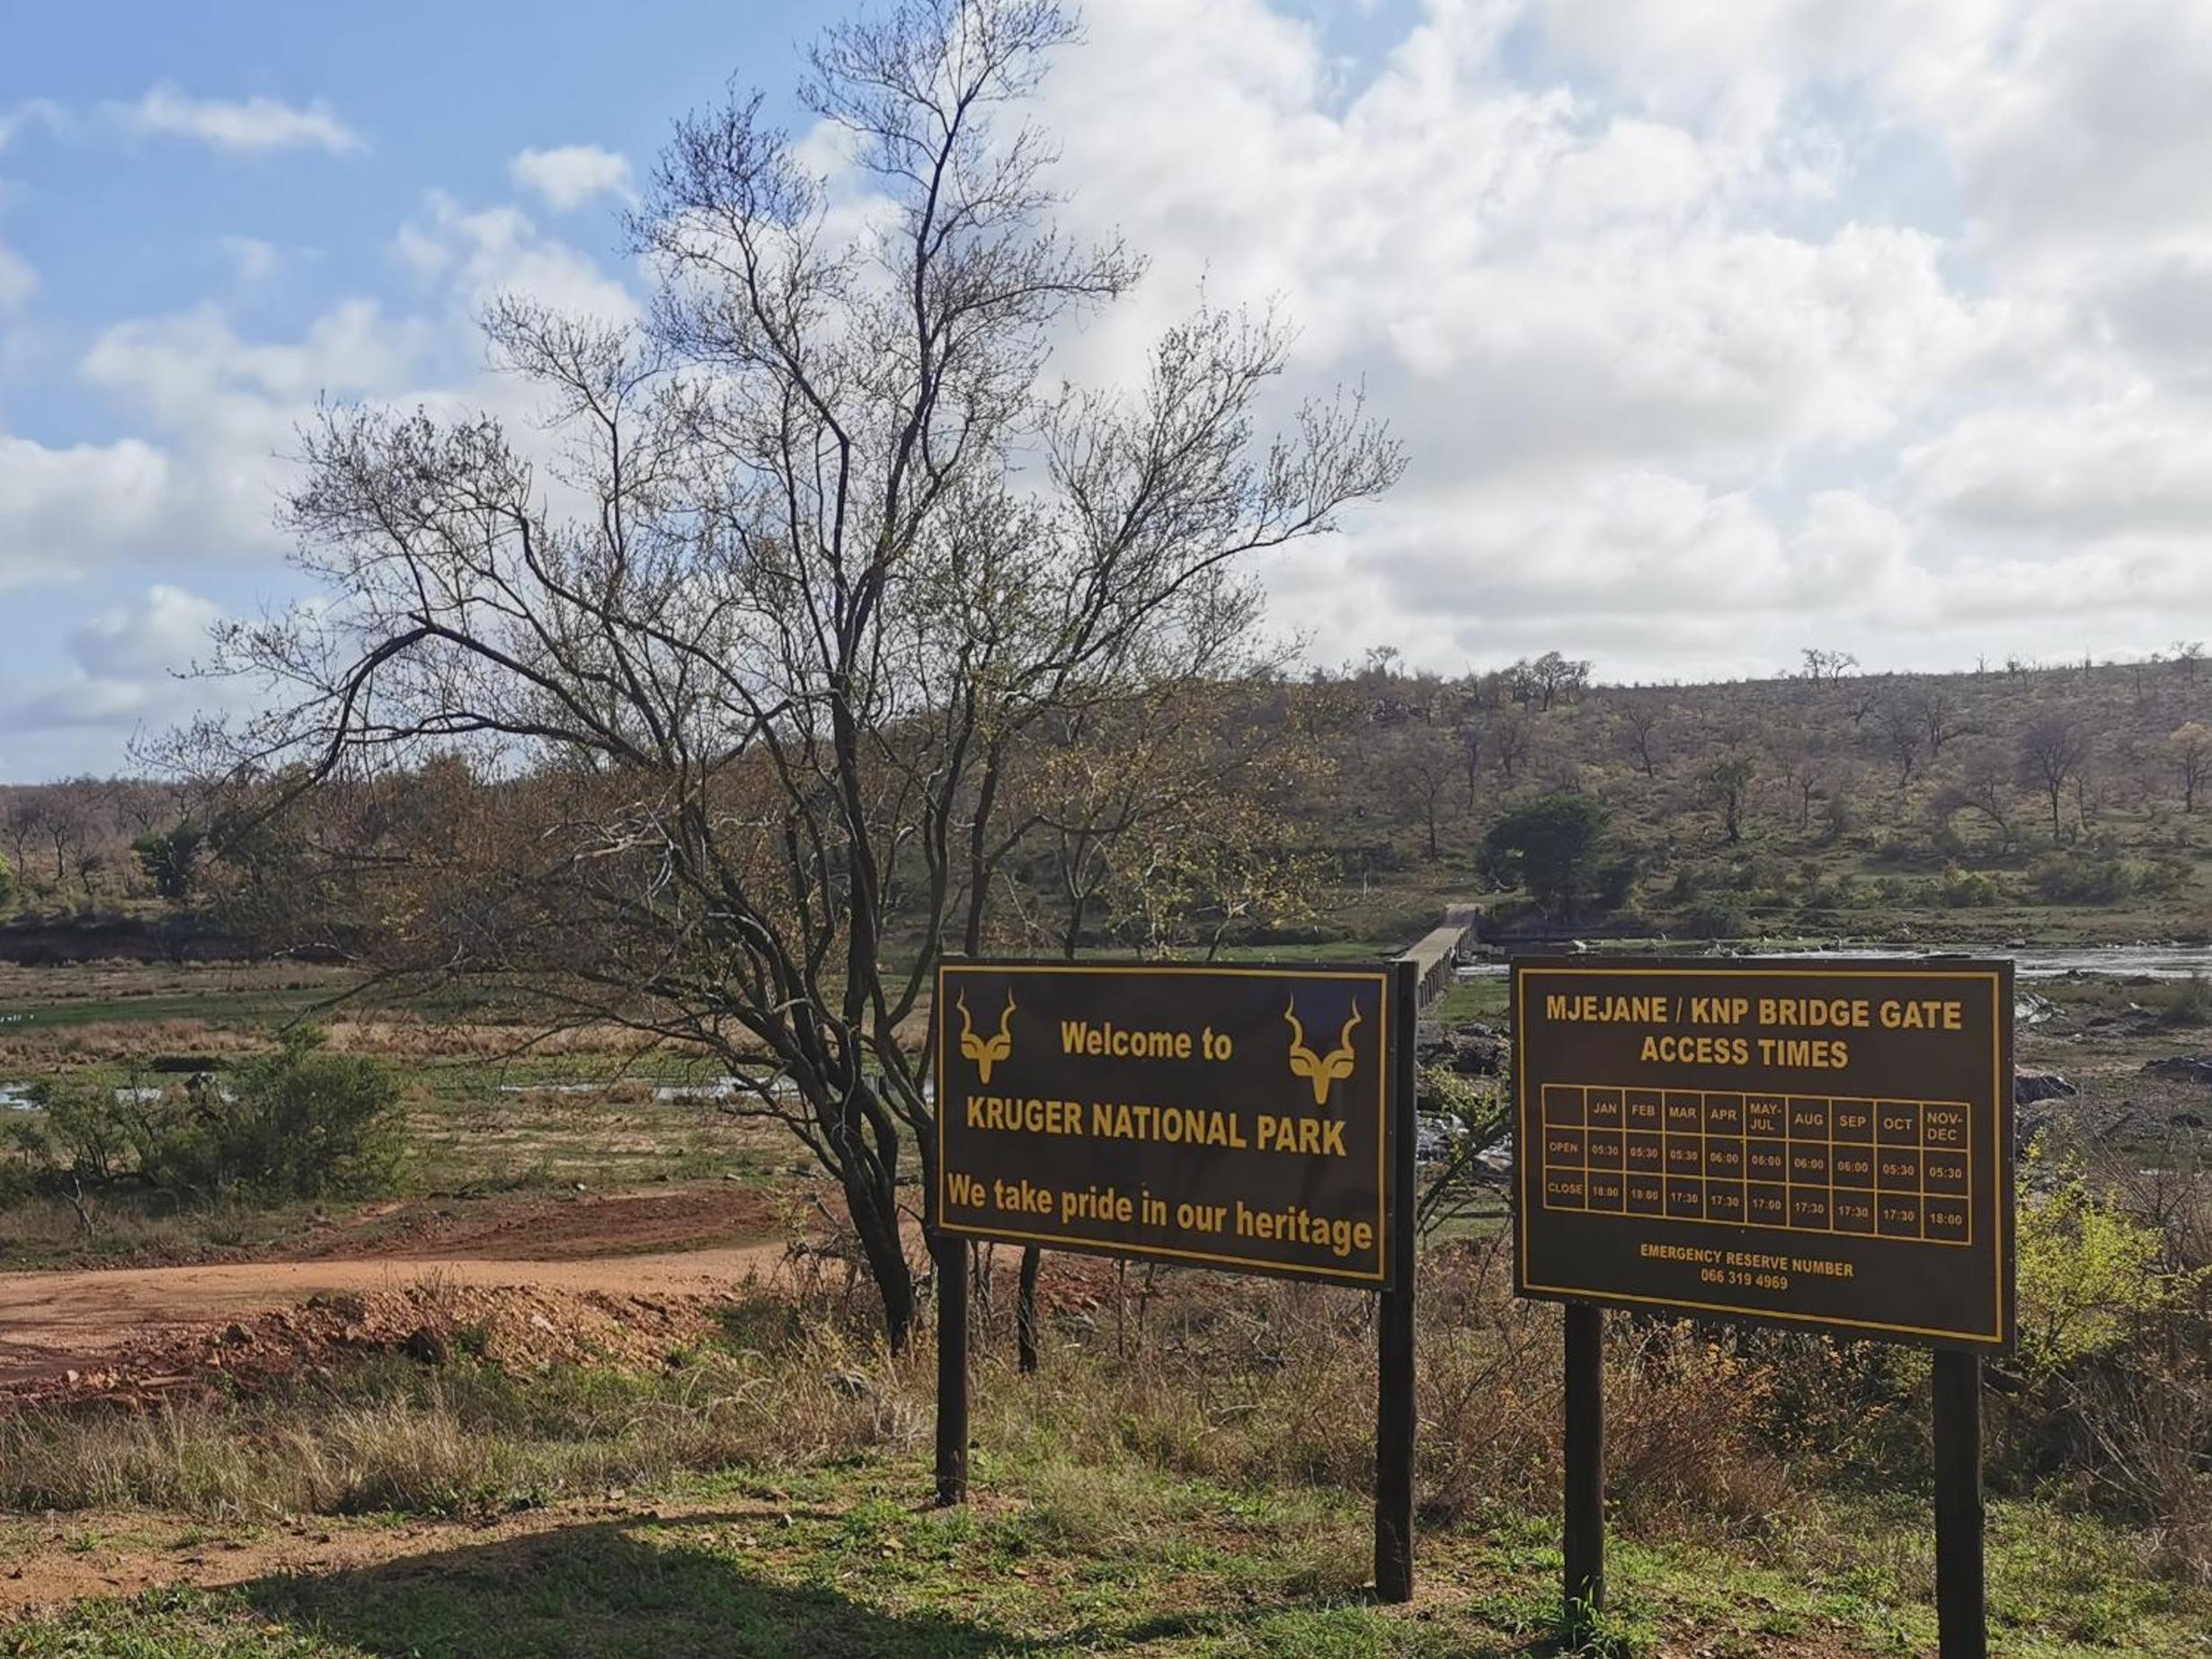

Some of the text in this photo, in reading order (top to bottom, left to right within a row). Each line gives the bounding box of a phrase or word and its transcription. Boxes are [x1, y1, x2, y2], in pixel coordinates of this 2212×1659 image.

[1546, 995, 1962, 1030] MJEJANE / KNP BRIDGE GATE
[1061, 1021, 1233, 1060] Welcome to
[1640, 1036, 1849, 1069] ACCESS TIMES
[1594, 1102, 1617, 1114] JAN
[1631, 1105, 1655, 1116] FEB
[1669, 1107, 1696, 1119] MAR
[1750, 1102, 1782, 1115] MAY-
[1710, 1109, 1737, 1121] APR
[1795, 1113, 1823, 1125] AUG
[1840, 1115, 1866, 1128] SEP
[1926, 1112, 1964, 1126] NOV-
[966, 1096, 1346, 1157] KRUGER NATIONAL PARK
[1751, 1120, 1774, 1131] JUL
[1885, 1118, 1912, 1130] OCT
[1928, 1129, 1957, 1140] DEC
[1550, 1142, 1577, 1154] OPEN
[1593, 1144, 1619, 1156] 05:30
[1630, 1147, 1657, 1159] 05:30
[1670, 1149, 1698, 1161] 05:30
[1710, 1150, 1739, 1164] 06:00
[1794, 1158, 1824, 1170] 06:00
[1838, 1160, 1868, 1173] 06:00
[1883, 1163, 1914, 1176] 05:30
[1930, 1166, 1962, 1179] 05:30
[1548, 1183, 1963, 1226] CLOSE 18:00 18:00 17:30 17:30 17:00 17:30 17:30 17:30 18:00
[947, 1172, 1373, 1256] We take pride in our heritage
[1641, 1244, 1853, 1277] EMERGENCY RESERVE NUMBER
[1701, 1269, 1789, 1290] 066 319 4969
